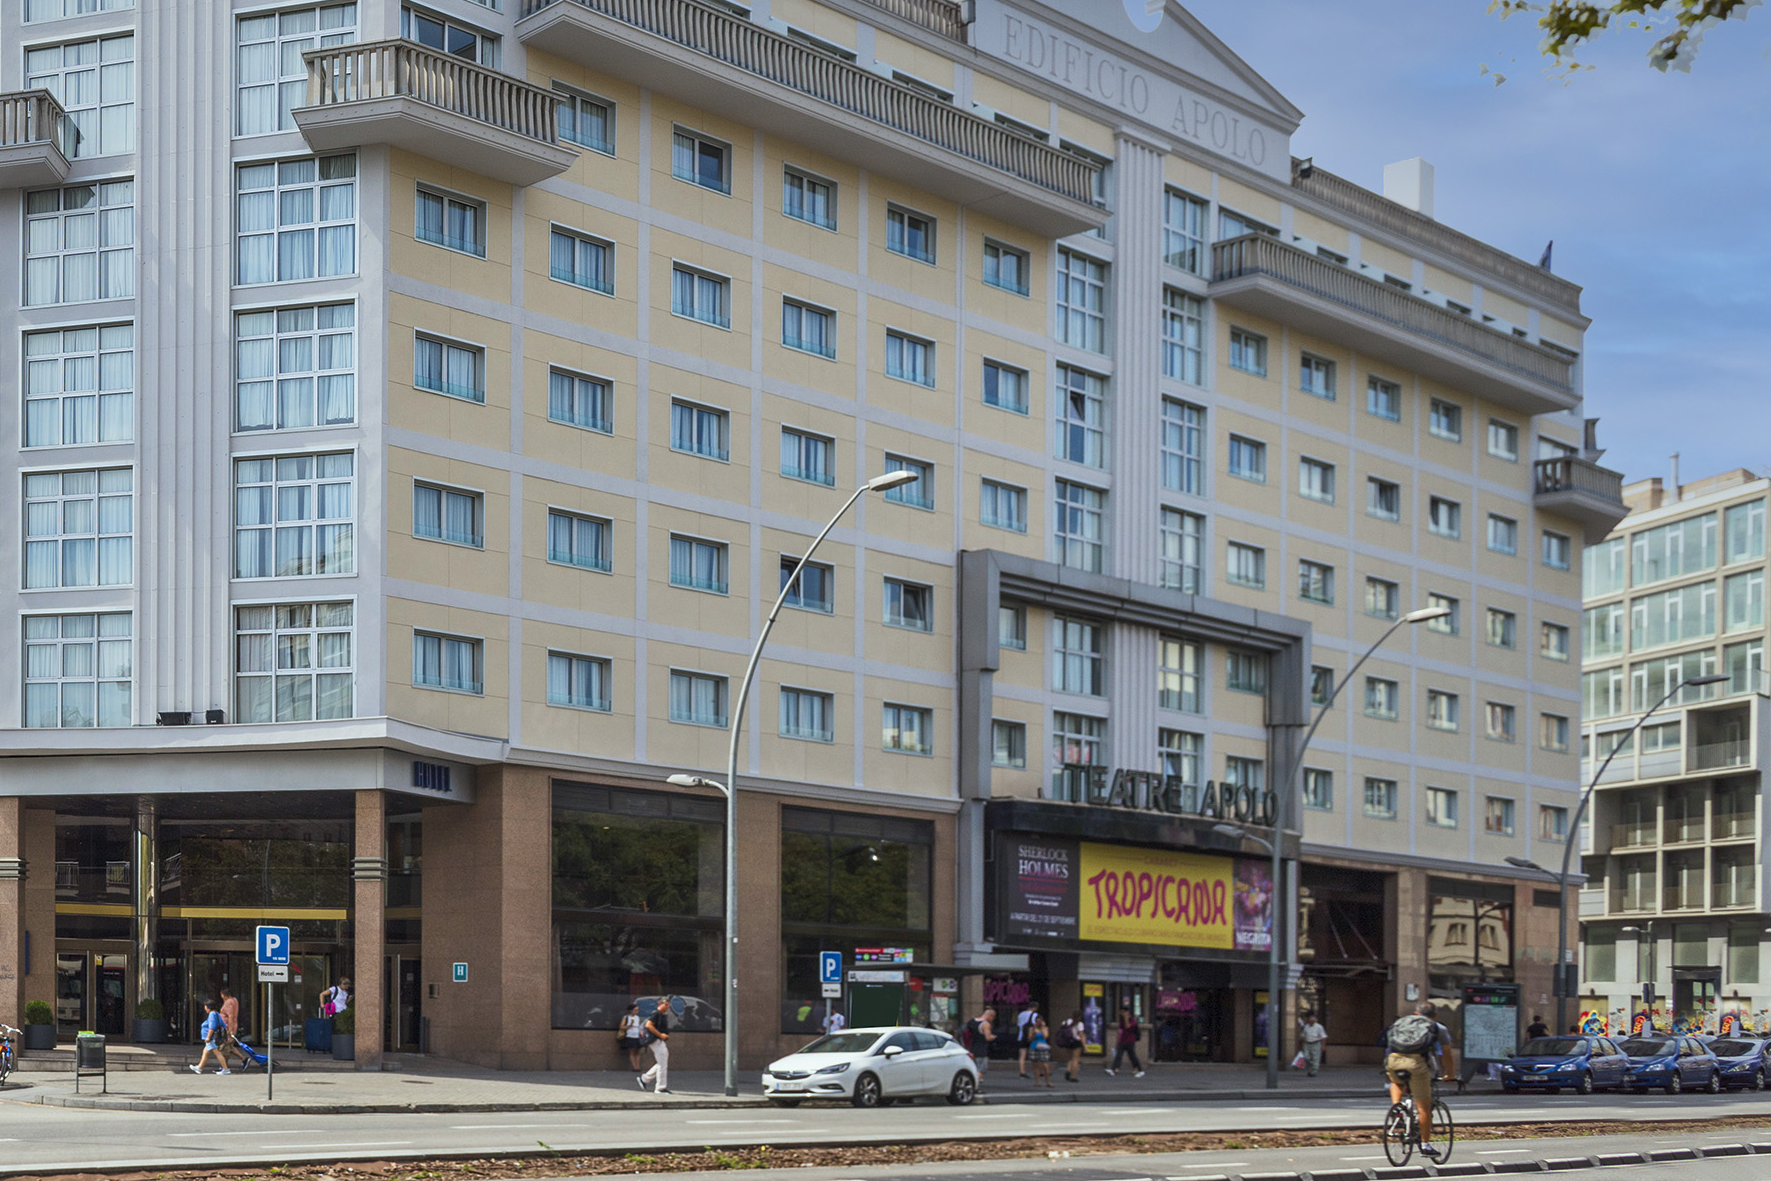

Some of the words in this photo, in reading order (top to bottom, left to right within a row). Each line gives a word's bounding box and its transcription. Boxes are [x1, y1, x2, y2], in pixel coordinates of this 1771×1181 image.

[1003, 13, 1149, 115] EDIFICIO
[1172, 94, 1266, 167] APOLO
[1063, 763, 1183, 814] TEATRE
[1200, 780, 1278, 827] APOLO
[1018, 845, 1068, 861] SHERLOCK
[1018, 859, 1069, 878] HOLMES
[1088, 869, 1227, 927] TROPICANA
[266, 934, 281, 957] P
[457, 966, 464, 976] H
[826, 958, 836, 978] P
